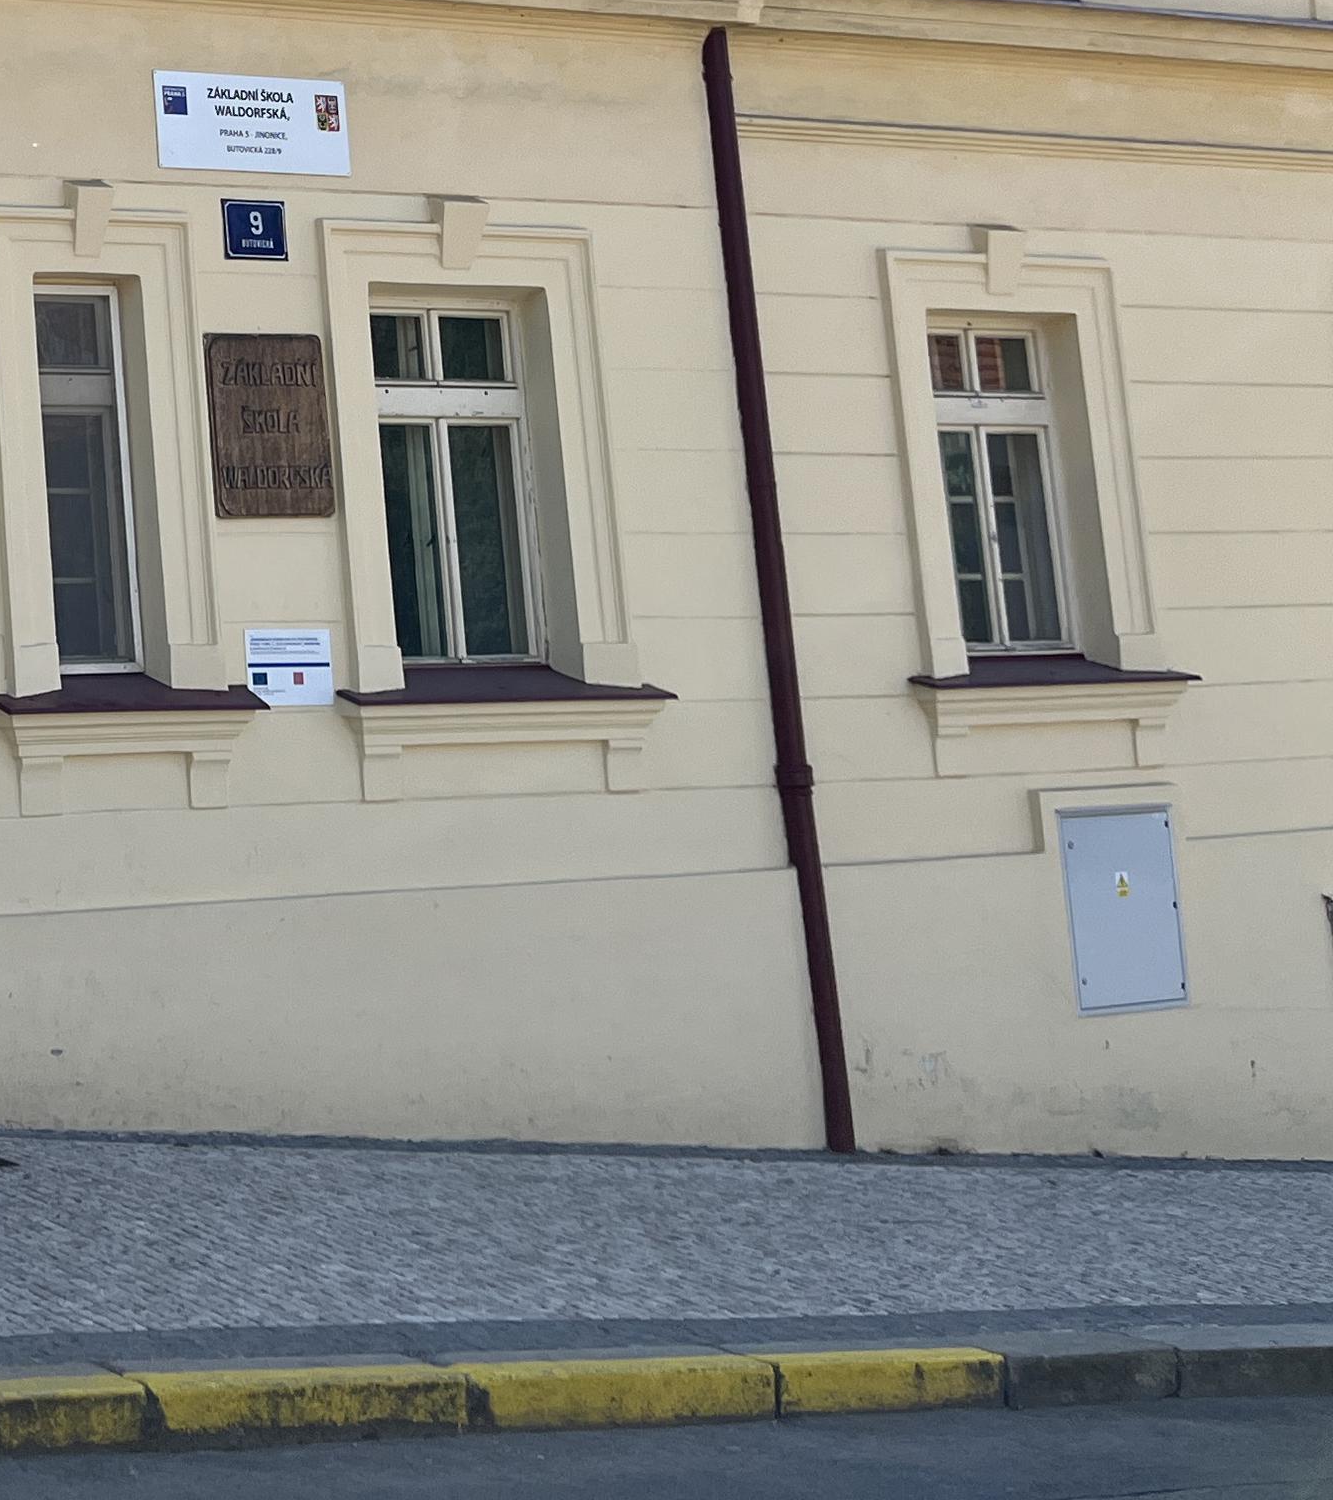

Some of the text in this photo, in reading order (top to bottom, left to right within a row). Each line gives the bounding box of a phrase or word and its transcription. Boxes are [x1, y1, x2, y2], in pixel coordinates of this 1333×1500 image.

[206, 86, 294, 103] ZÁKLADNÍ ŠKOLA
[219, 129, 243, 137] PRAHA
[249, 211, 263, 235] 9
[221, 358, 317, 388] ZÁKLADNÍ
[241, 405, 301, 434] ŠKOLA
